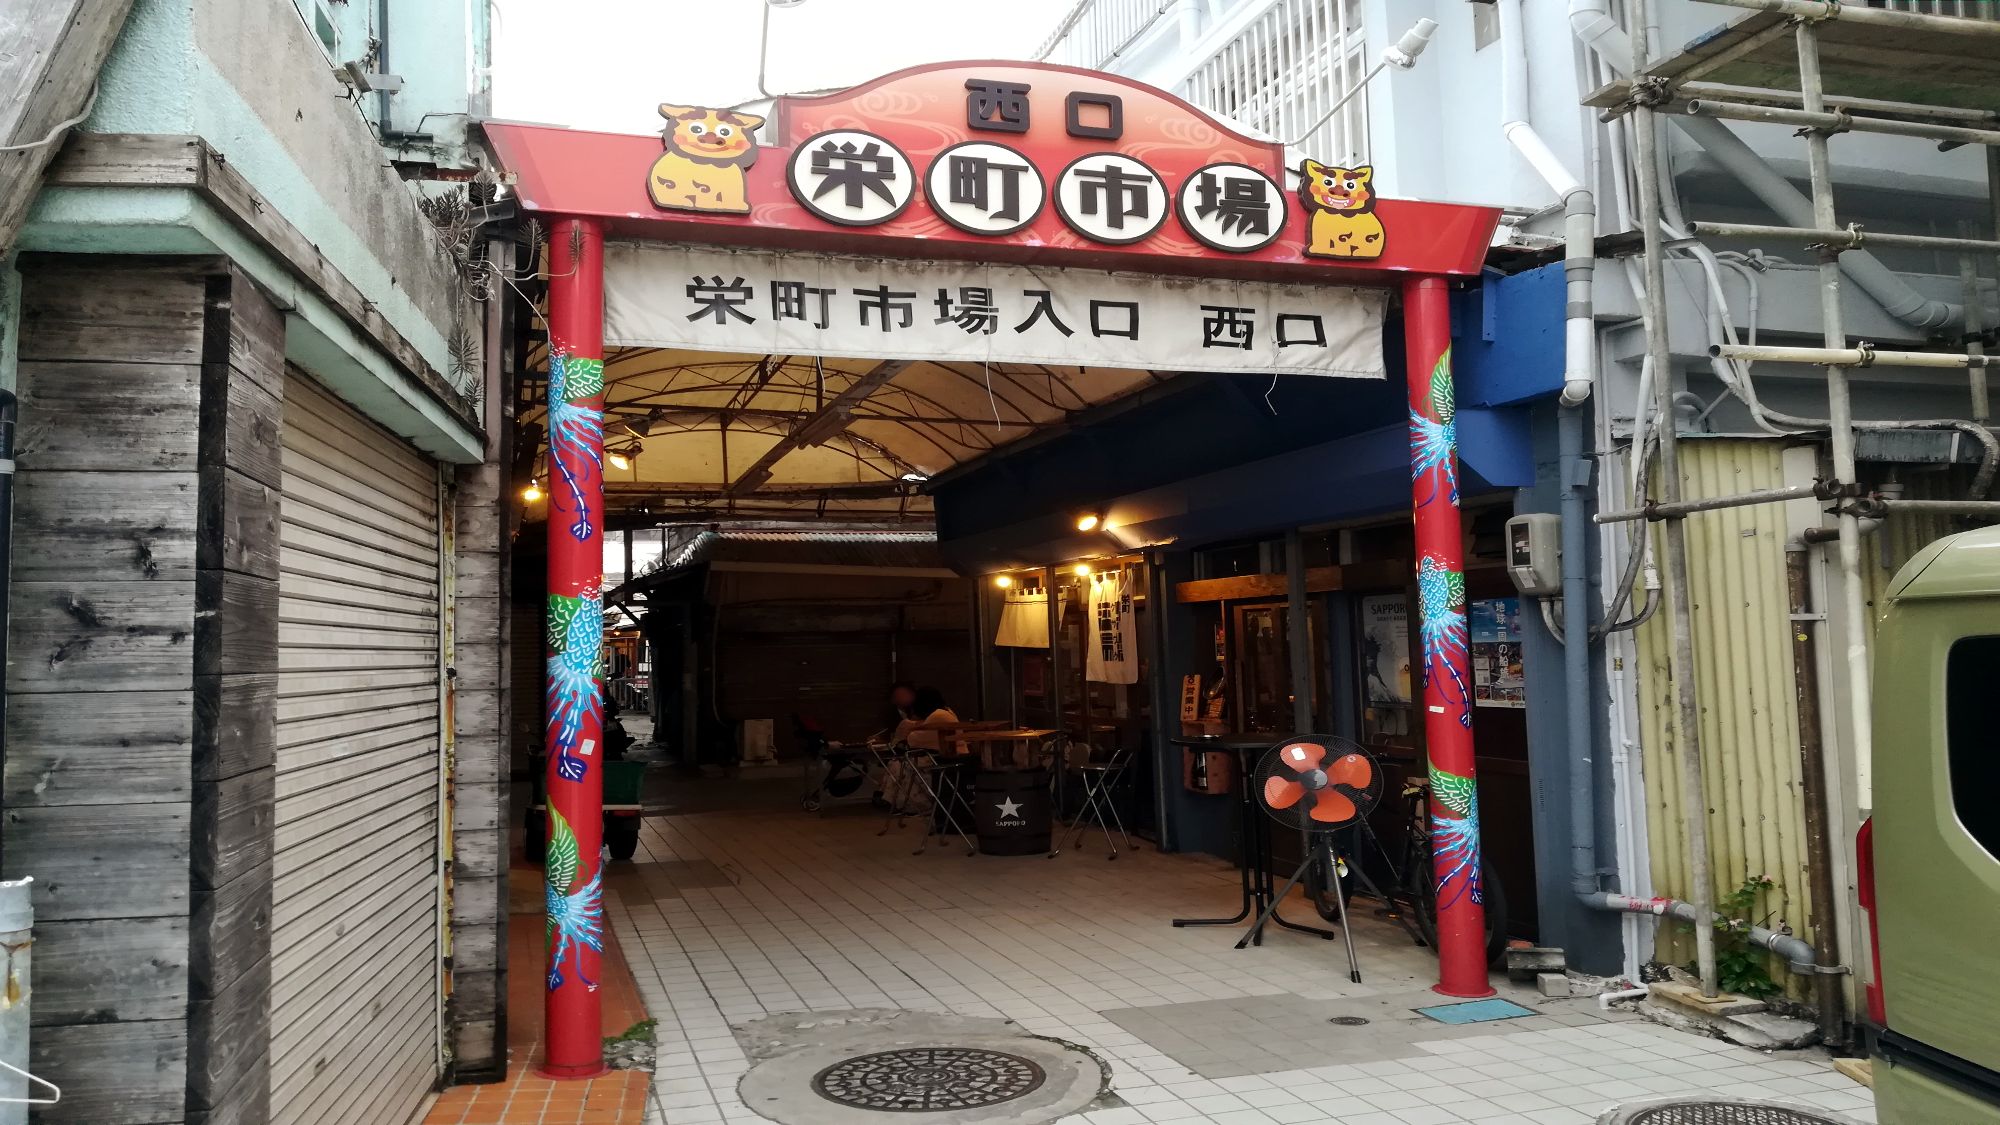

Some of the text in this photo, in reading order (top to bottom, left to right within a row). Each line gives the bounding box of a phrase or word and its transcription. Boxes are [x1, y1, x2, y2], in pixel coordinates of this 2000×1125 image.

[965, 78, 1123, 139] 西口
[811, 140, 1271, 237] 栄町市場
[685, 274, 1329, 351] 栄町市場入口 西口
[1371, 603, 1407, 615] SAPPOR
